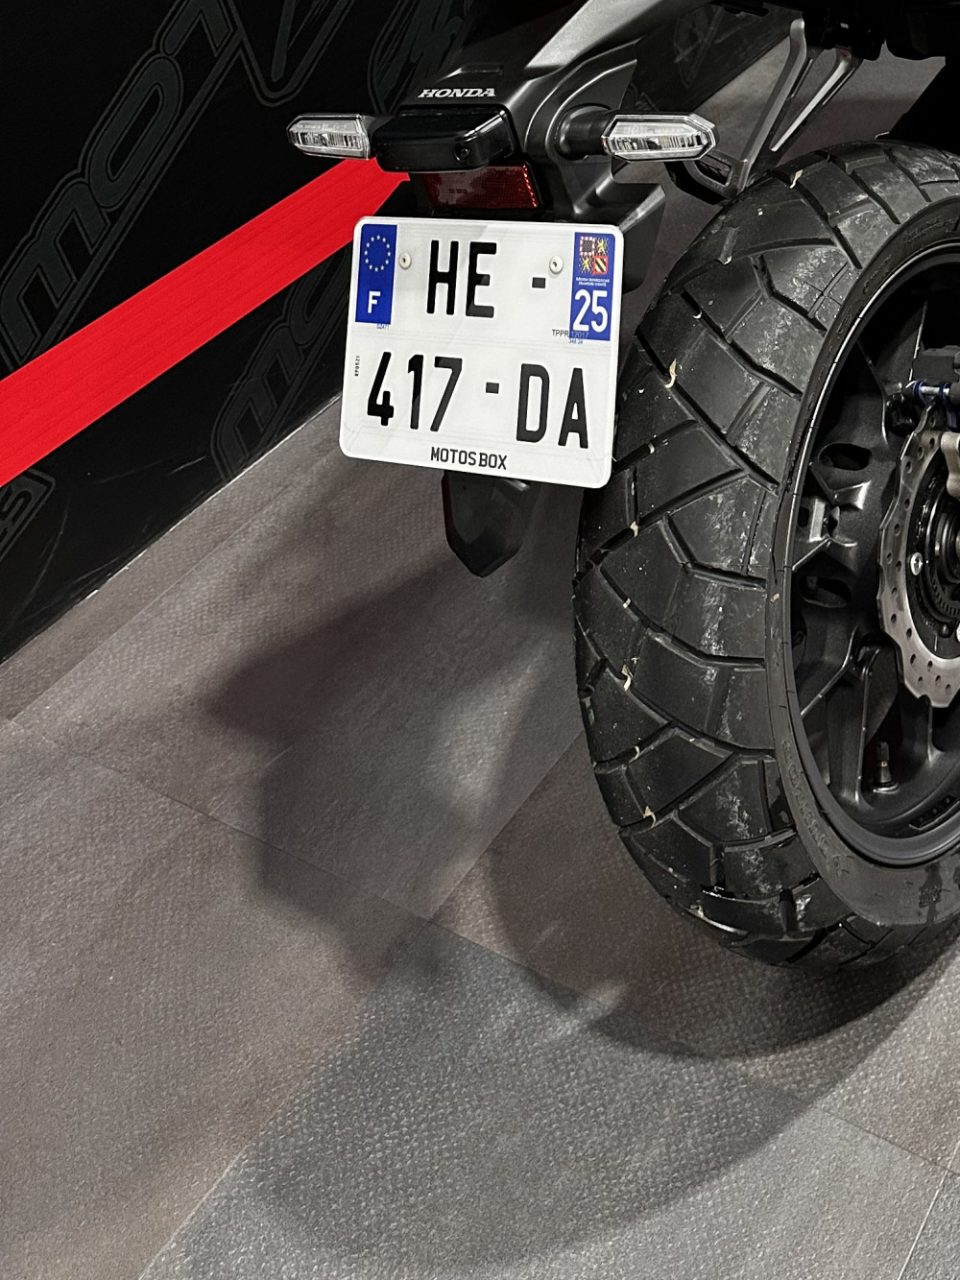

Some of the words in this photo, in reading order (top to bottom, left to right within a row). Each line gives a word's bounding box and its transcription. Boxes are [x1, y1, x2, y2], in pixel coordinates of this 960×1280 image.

[417, 87, 496, 99] HONDA
[427, 240, 497, 318] HE
[367, 290, 382, 314] F
[573, 288, 609, 333] 25
[367, 351, 463, 432] 417
[516, 363, 589, 449] DA
